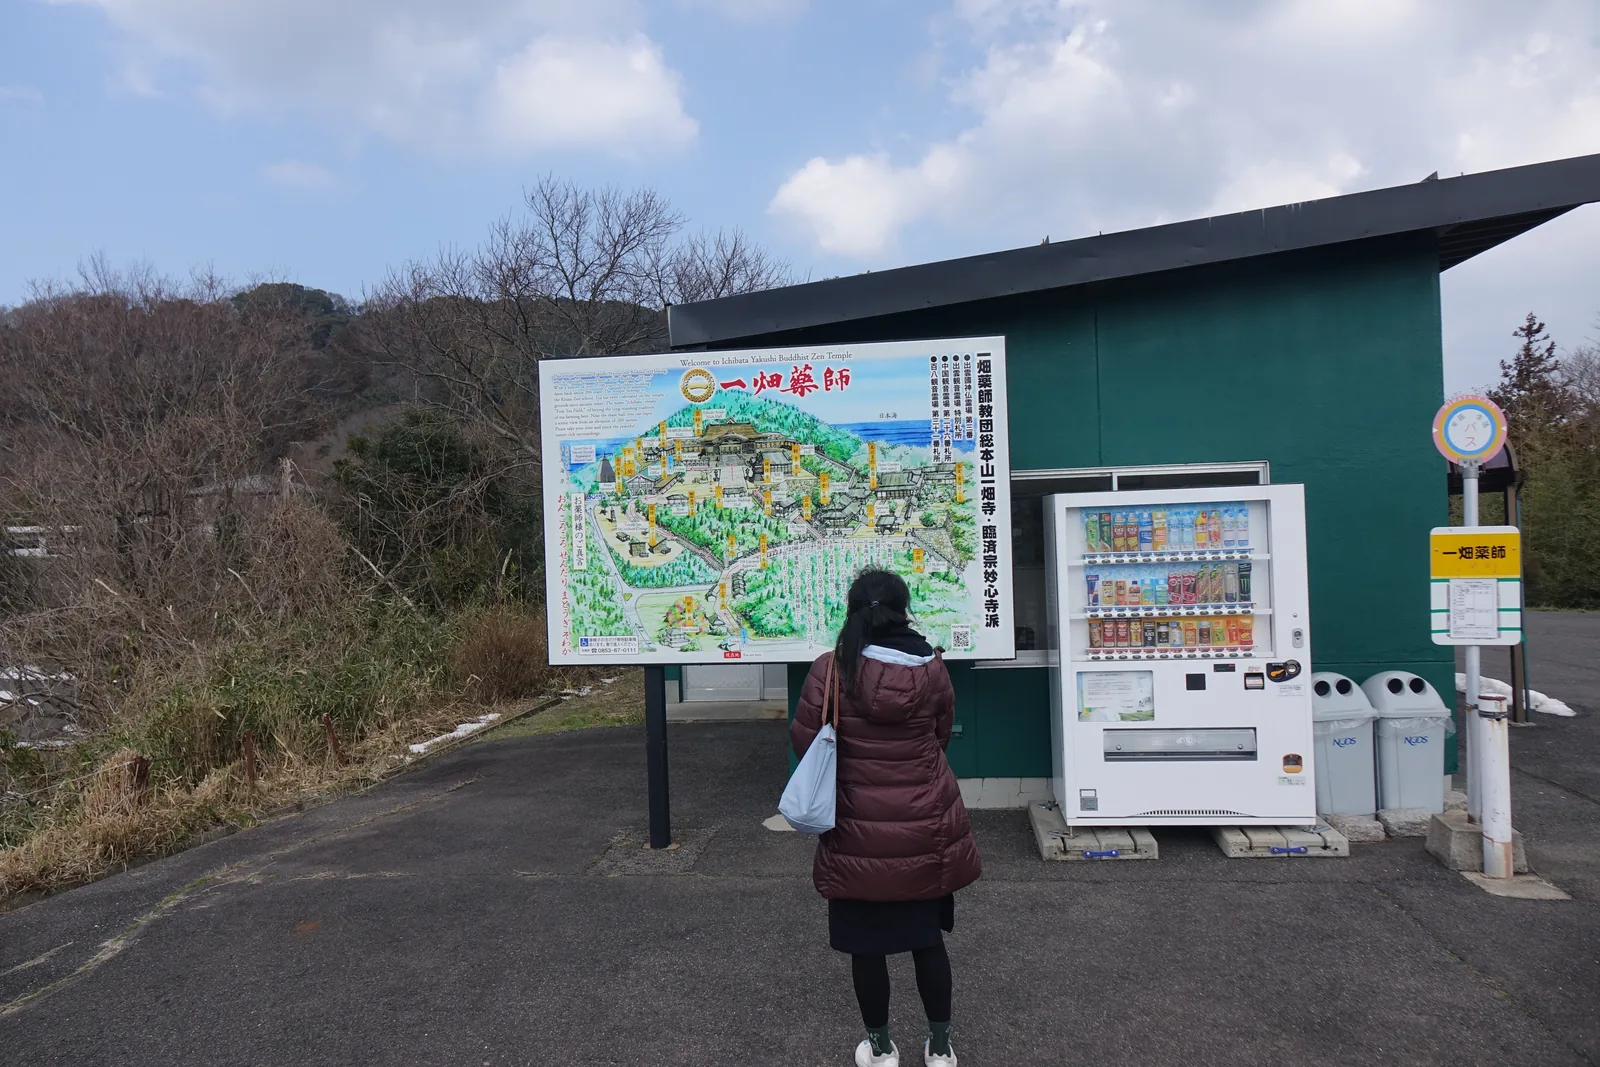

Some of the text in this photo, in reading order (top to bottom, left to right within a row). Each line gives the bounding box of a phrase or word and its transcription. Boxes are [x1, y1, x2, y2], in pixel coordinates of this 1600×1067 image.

[680, 359, 711, 367] Welcome
[722, 357, 749, 365] Ichibata
[750, 355, 777, 363] Yakushi
[778, 354, 809, 362] Buddhist
[826, 352, 852, 361] Temple
[1464, 422, 1476, 447] バス
[574, 496, 584, 566] お薬師様のご真言
[1442, 545, 1506, 560] 一畑薬師
